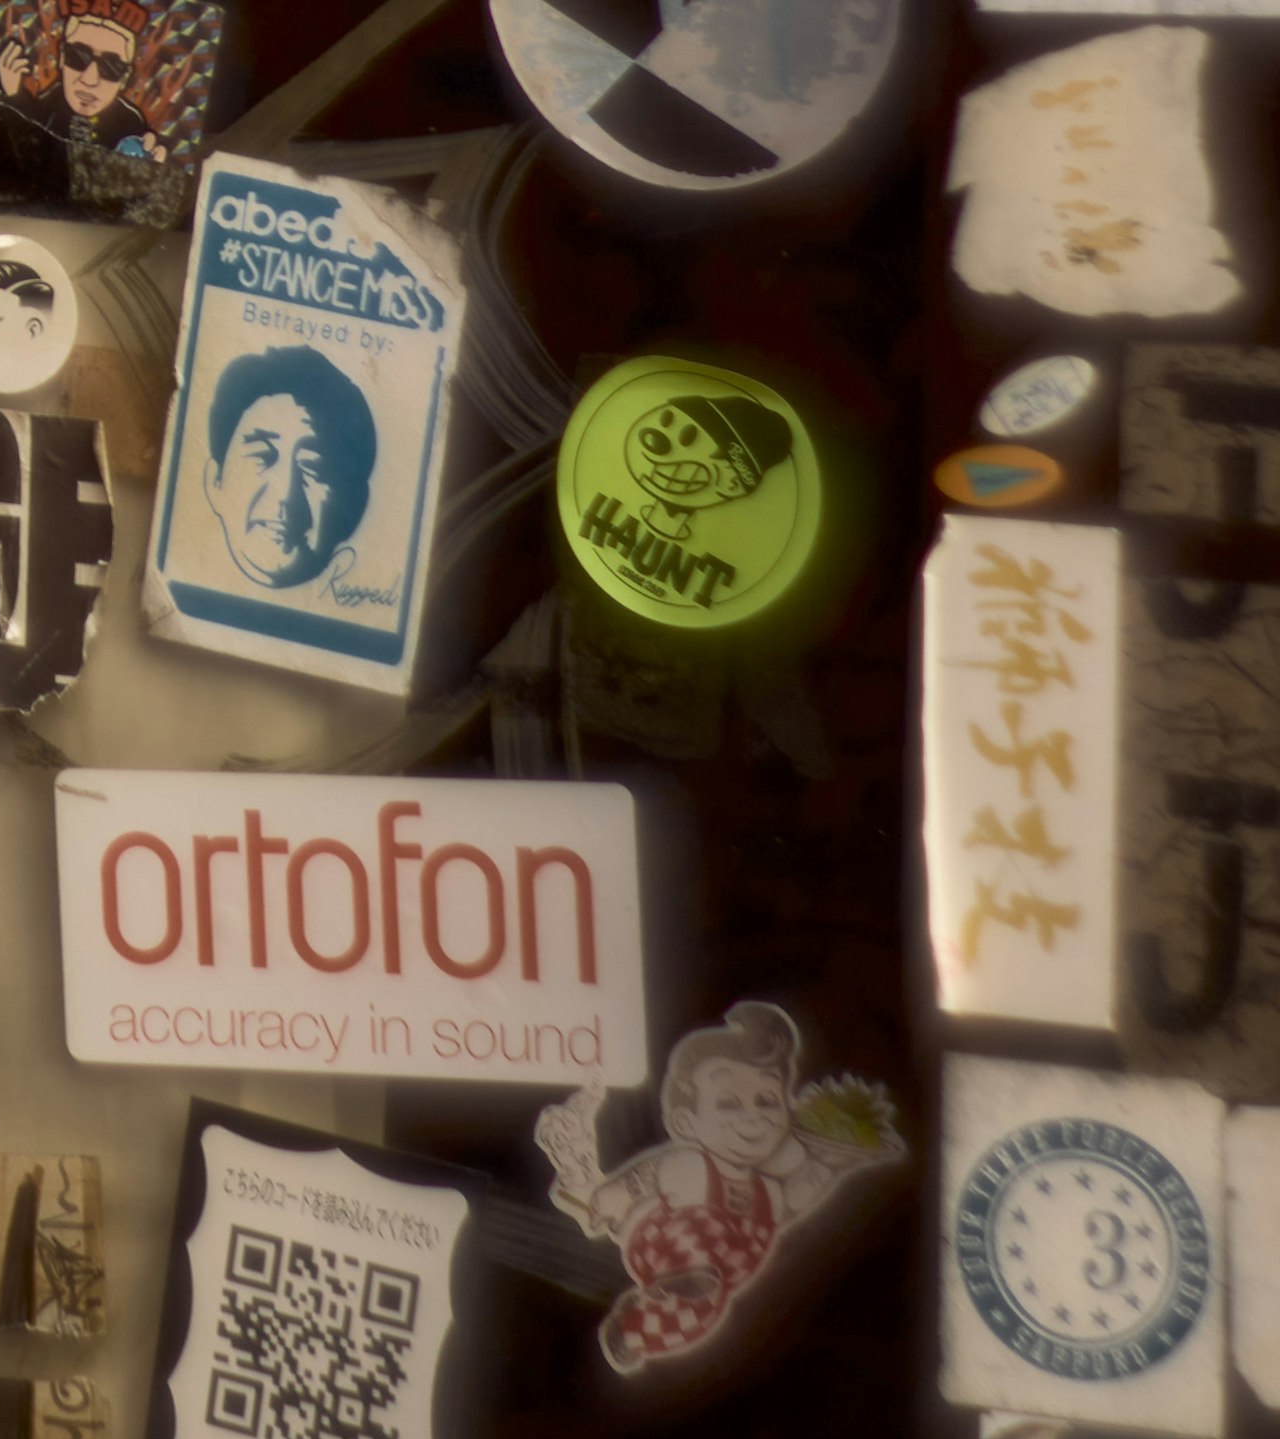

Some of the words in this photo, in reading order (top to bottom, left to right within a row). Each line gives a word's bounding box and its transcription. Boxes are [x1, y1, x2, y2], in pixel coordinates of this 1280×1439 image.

[241, 301, 348, 345] Betrayed
[359, 325, 395, 354] by:
[578, 491, 737, 610] HAUNT
[99, 798, 600, 985] ortofon
[109, 1002, 350, 1064] accuracy
[369, 1001, 412, 1056] in
[432, 1014, 602, 1067] sound
[1082, 1208, 1127, 1291] 3
[1010, 1323, 1150, 1374] SAPPORO
